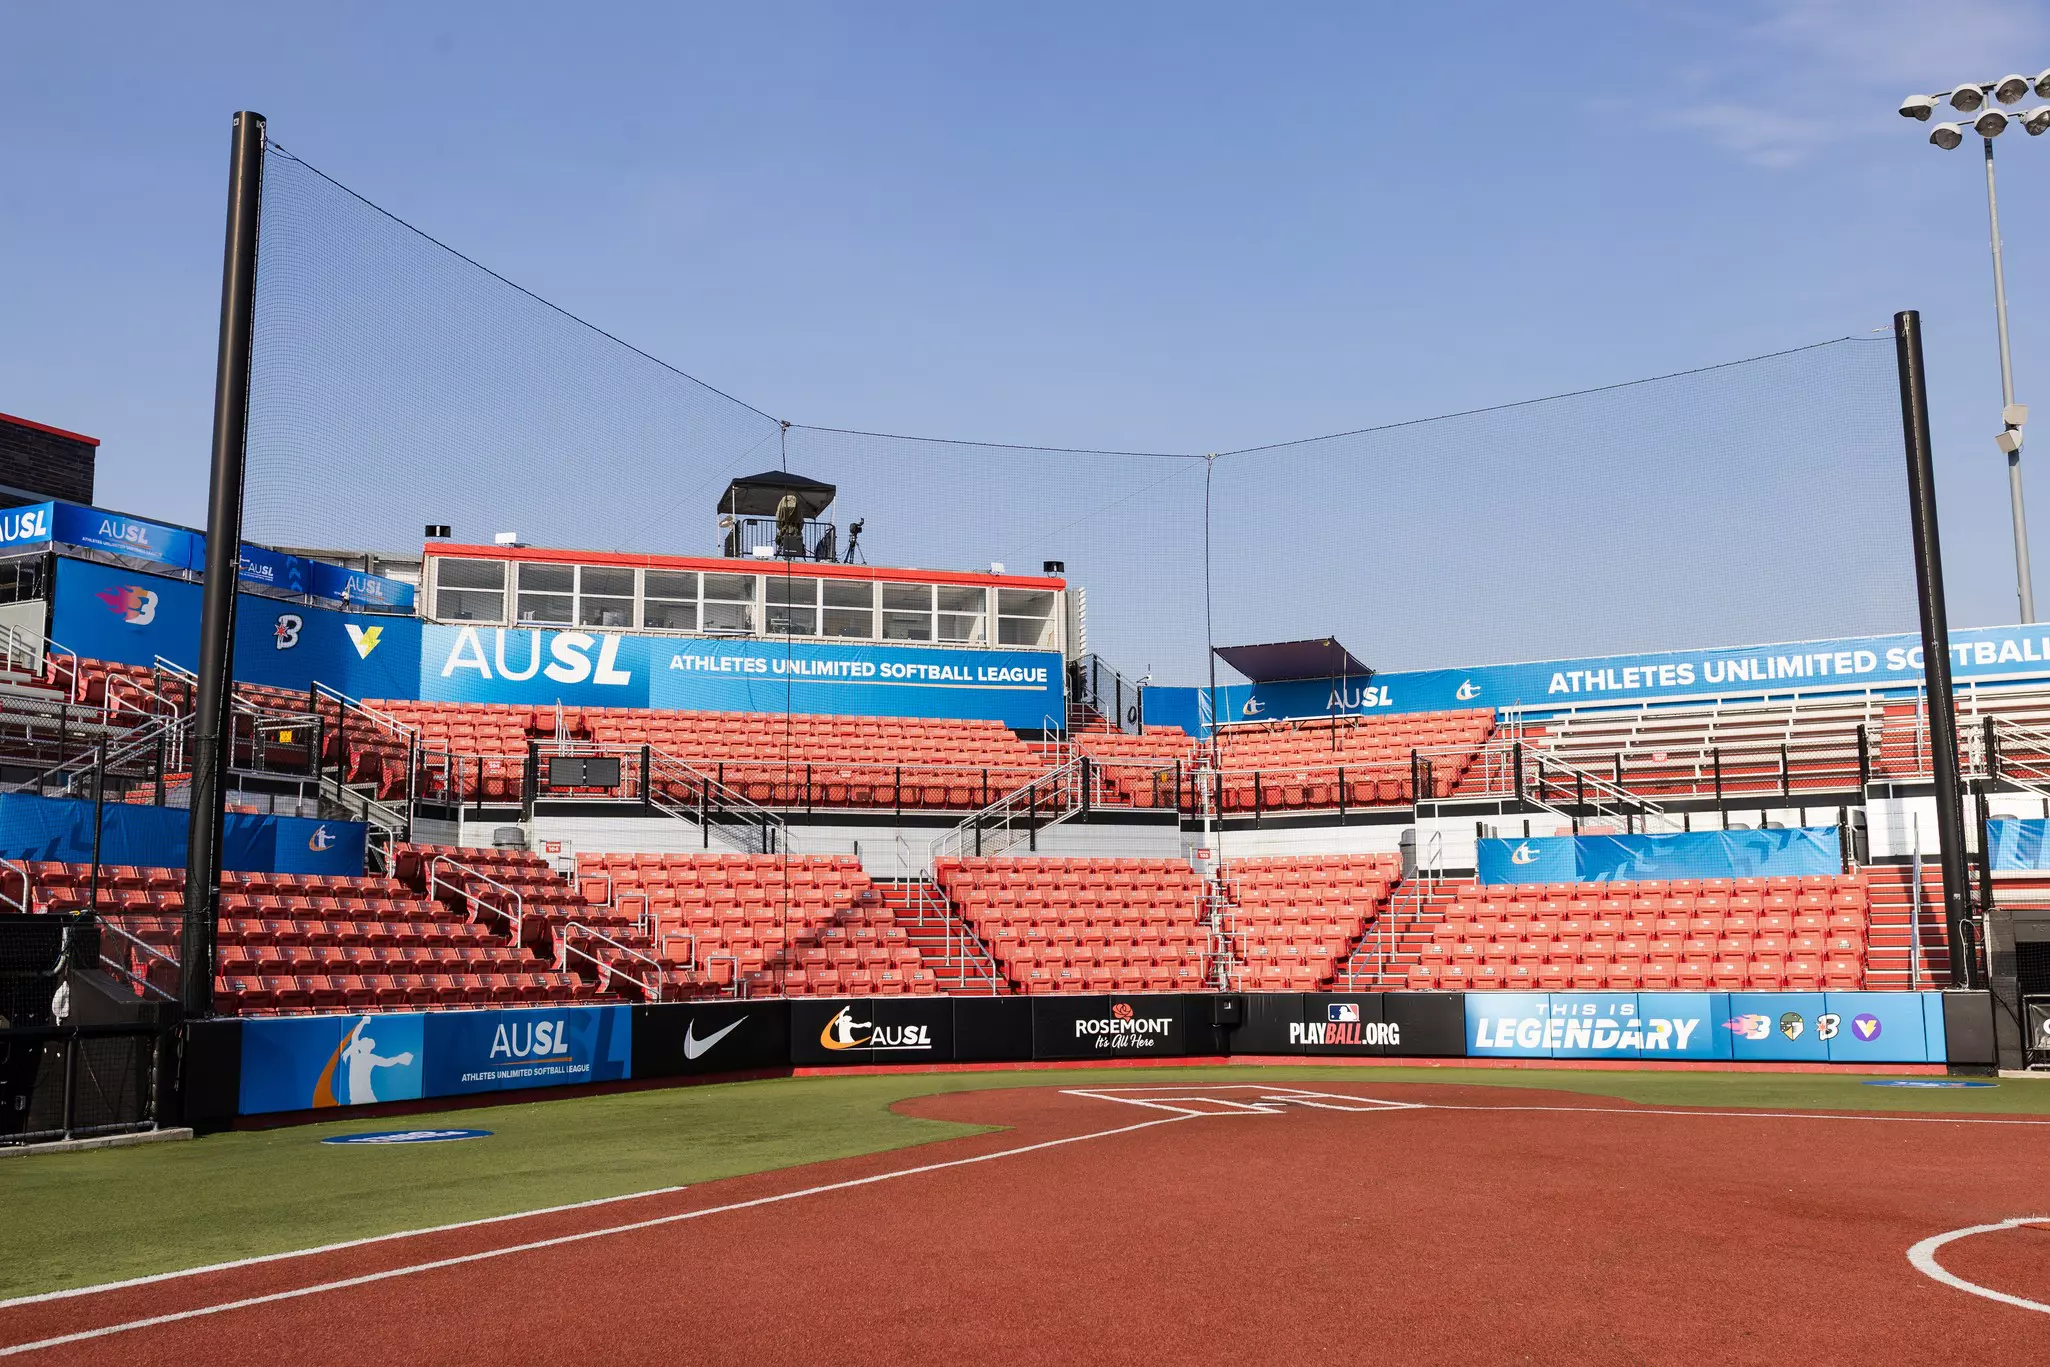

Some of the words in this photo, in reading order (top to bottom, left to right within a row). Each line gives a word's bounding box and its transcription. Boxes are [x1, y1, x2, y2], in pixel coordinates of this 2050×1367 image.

[99, 519, 149, 545] AUSL
[248, 563, 274, 577] AUSL
[347, 575, 384, 596] AUSL
[441, 626, 632, 686] AUSL
[1548, 663, 1696, 694] ATHLETES
[1703, 650, 1878, 684] UNLIMITED
[1886, 636, 2050, 671] SOTBAL
[669, 655, 768, 673] ATHLETES
[772, 658, 876, 677] UNLIMITED
[880, 662, 973, 681] SOFTBALL
[978, 666, 1048, 683] LEAGUE
[1326, 686, 1393, 710] AUSL
[1535, 1003, 1597, 1016] THIS
[1609, 1003, 1635, 1016] IS
[489, 1020, 569, 1059] AUSL
[869, 1025, 932, 1046] AUSL
[1075, 1018, 1173, 1038] ROSEMONT
[1289, 1022, 1400, 1045] PLAYBALL.ORG
[1475, 1018, 1701, 1050] LEGENDARY
[1095, 1034, 1110, 1049] It's
[1112, 1033, 1129, 1049] All
[1130, 1033, 1155, 1049] Here
[461, 1071, 496, 1082] ATHLETES
[497, 1068, 533, 1079] UNLIMITED
[533, 1065, 566, 1076] SOFTBALL
[566, 1063, 590, 1074] LEAGUE
